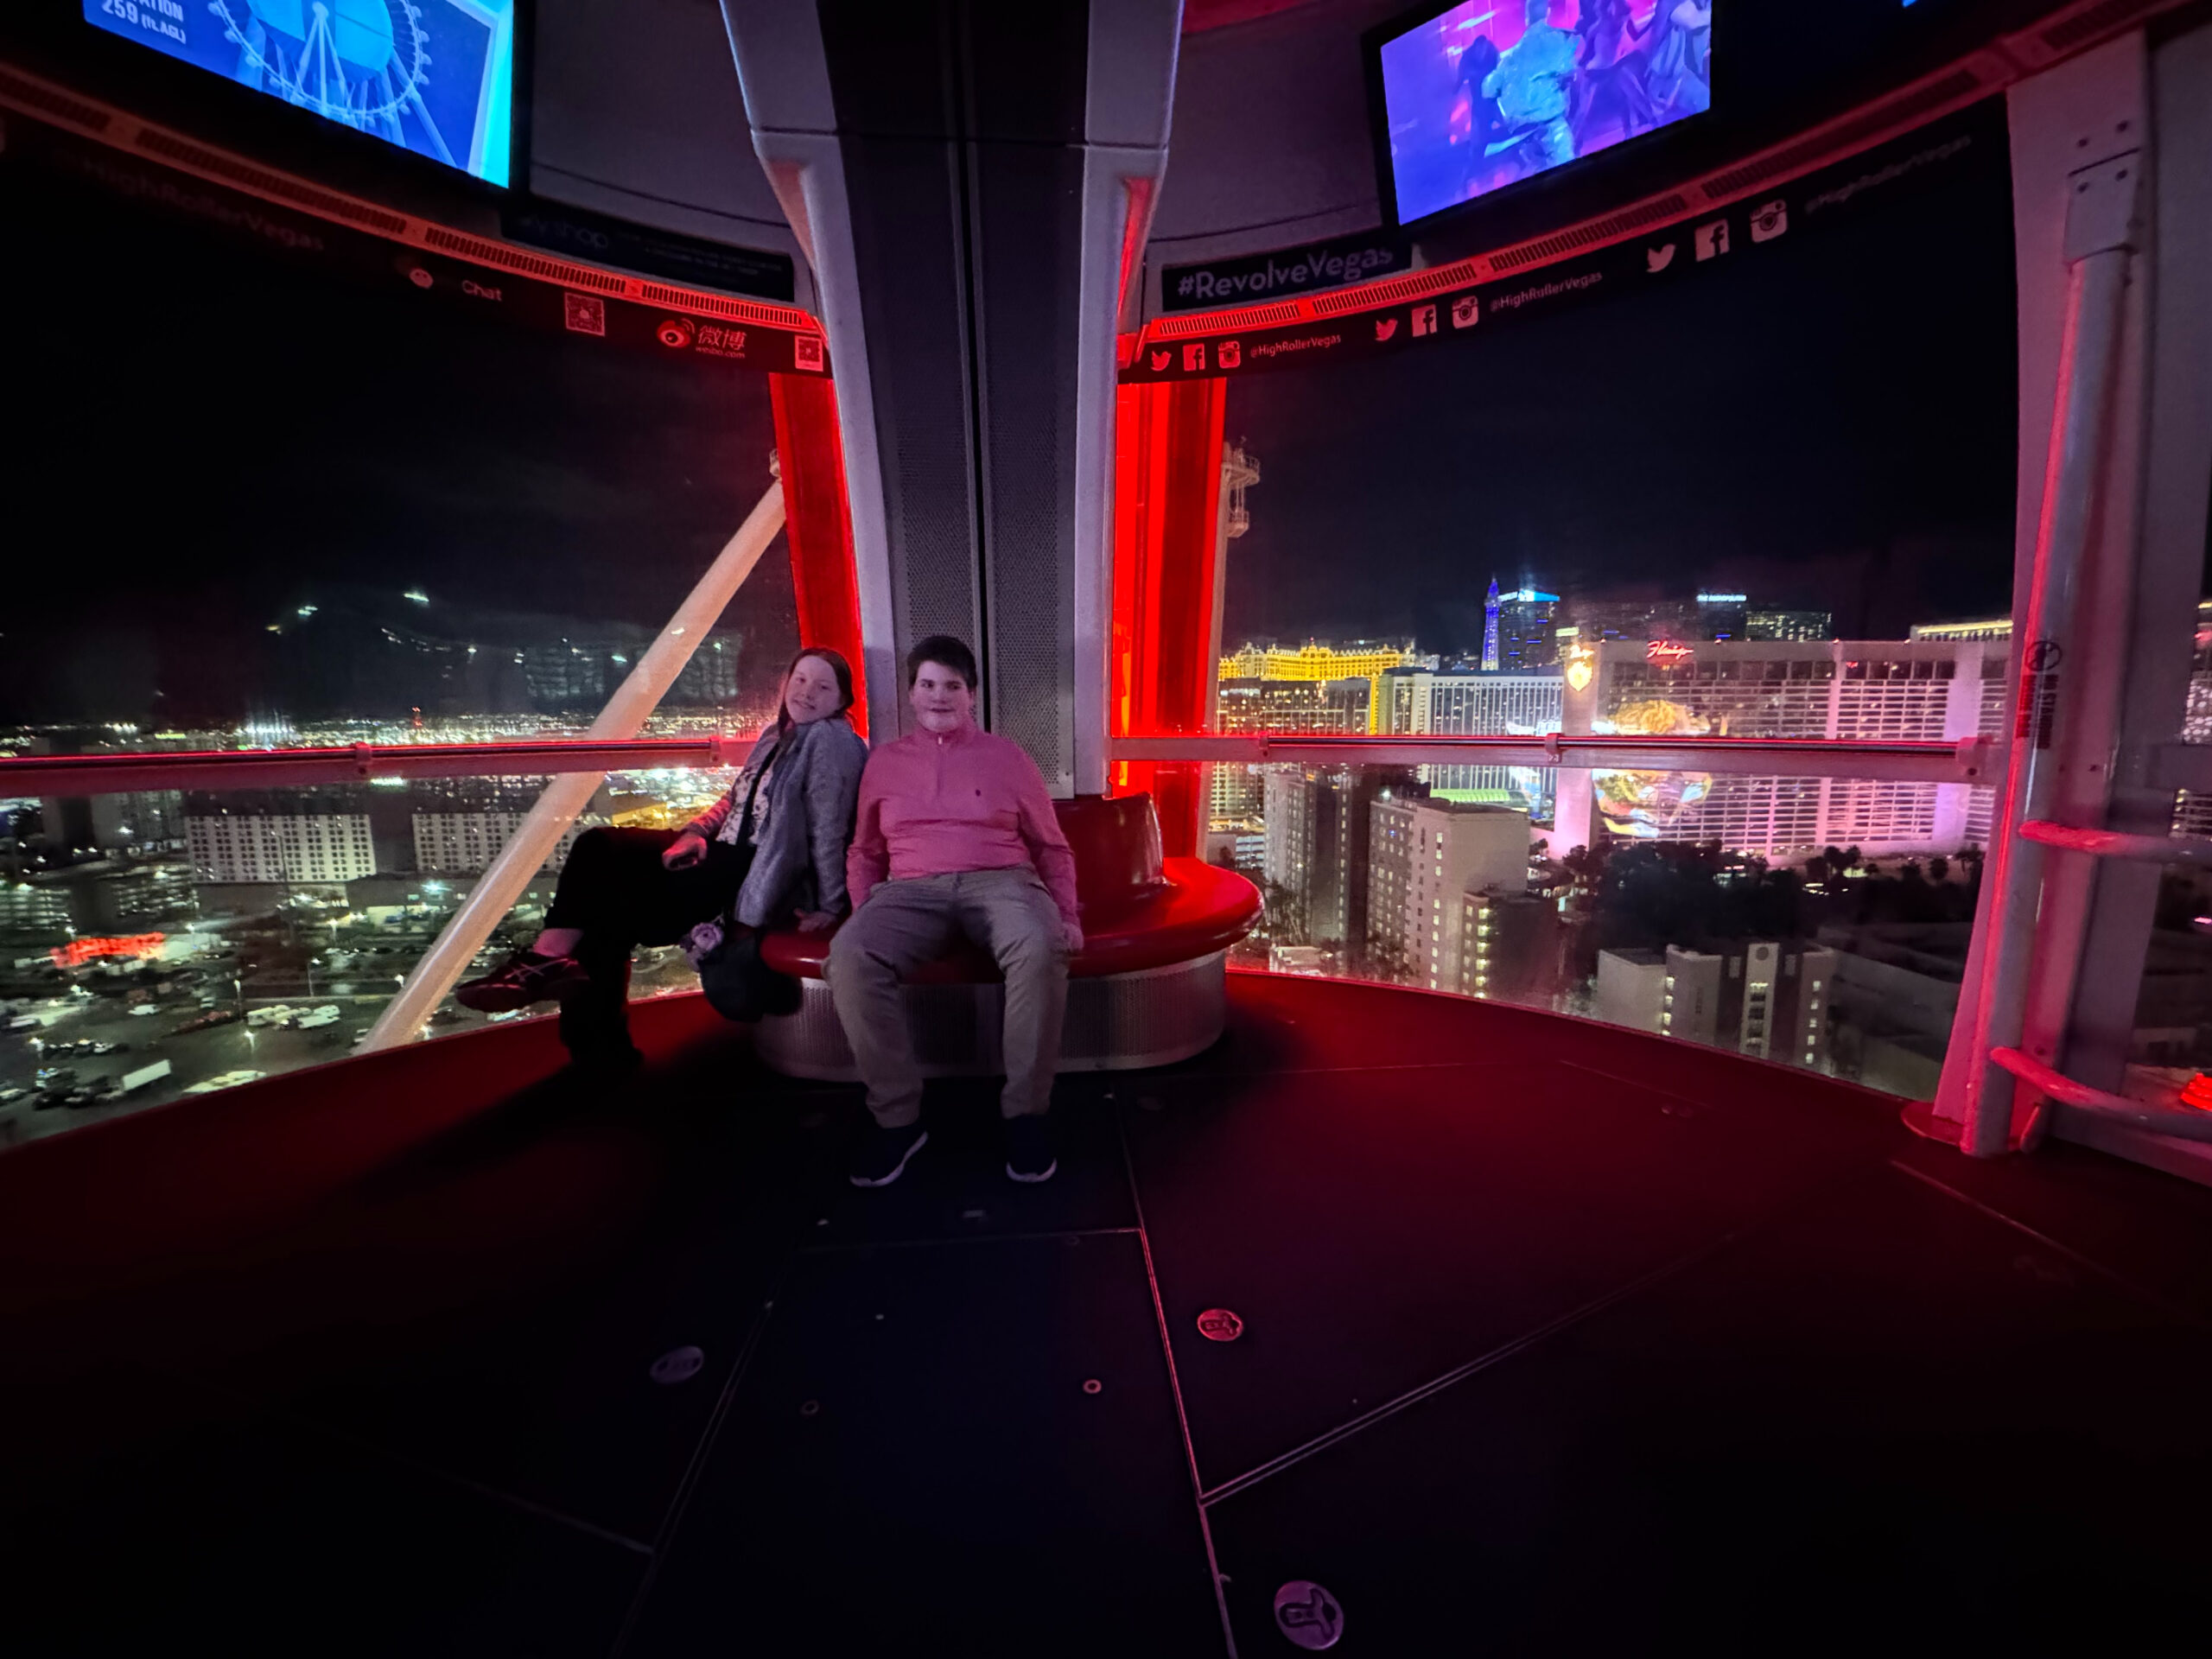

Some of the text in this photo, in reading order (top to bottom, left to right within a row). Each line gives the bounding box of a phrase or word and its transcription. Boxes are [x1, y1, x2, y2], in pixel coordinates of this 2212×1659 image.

[102, 0, 138, 24] 259
[1177, 246, 1395, 300] #RevolveVegas
[461, 279, 503, 302] Chat
[1490, 271, 1603, 313] @HighRollerVegas
[698, 325, 747, 351] 微博
[1250, 334, 1342, 359] @HighRollerVegas
